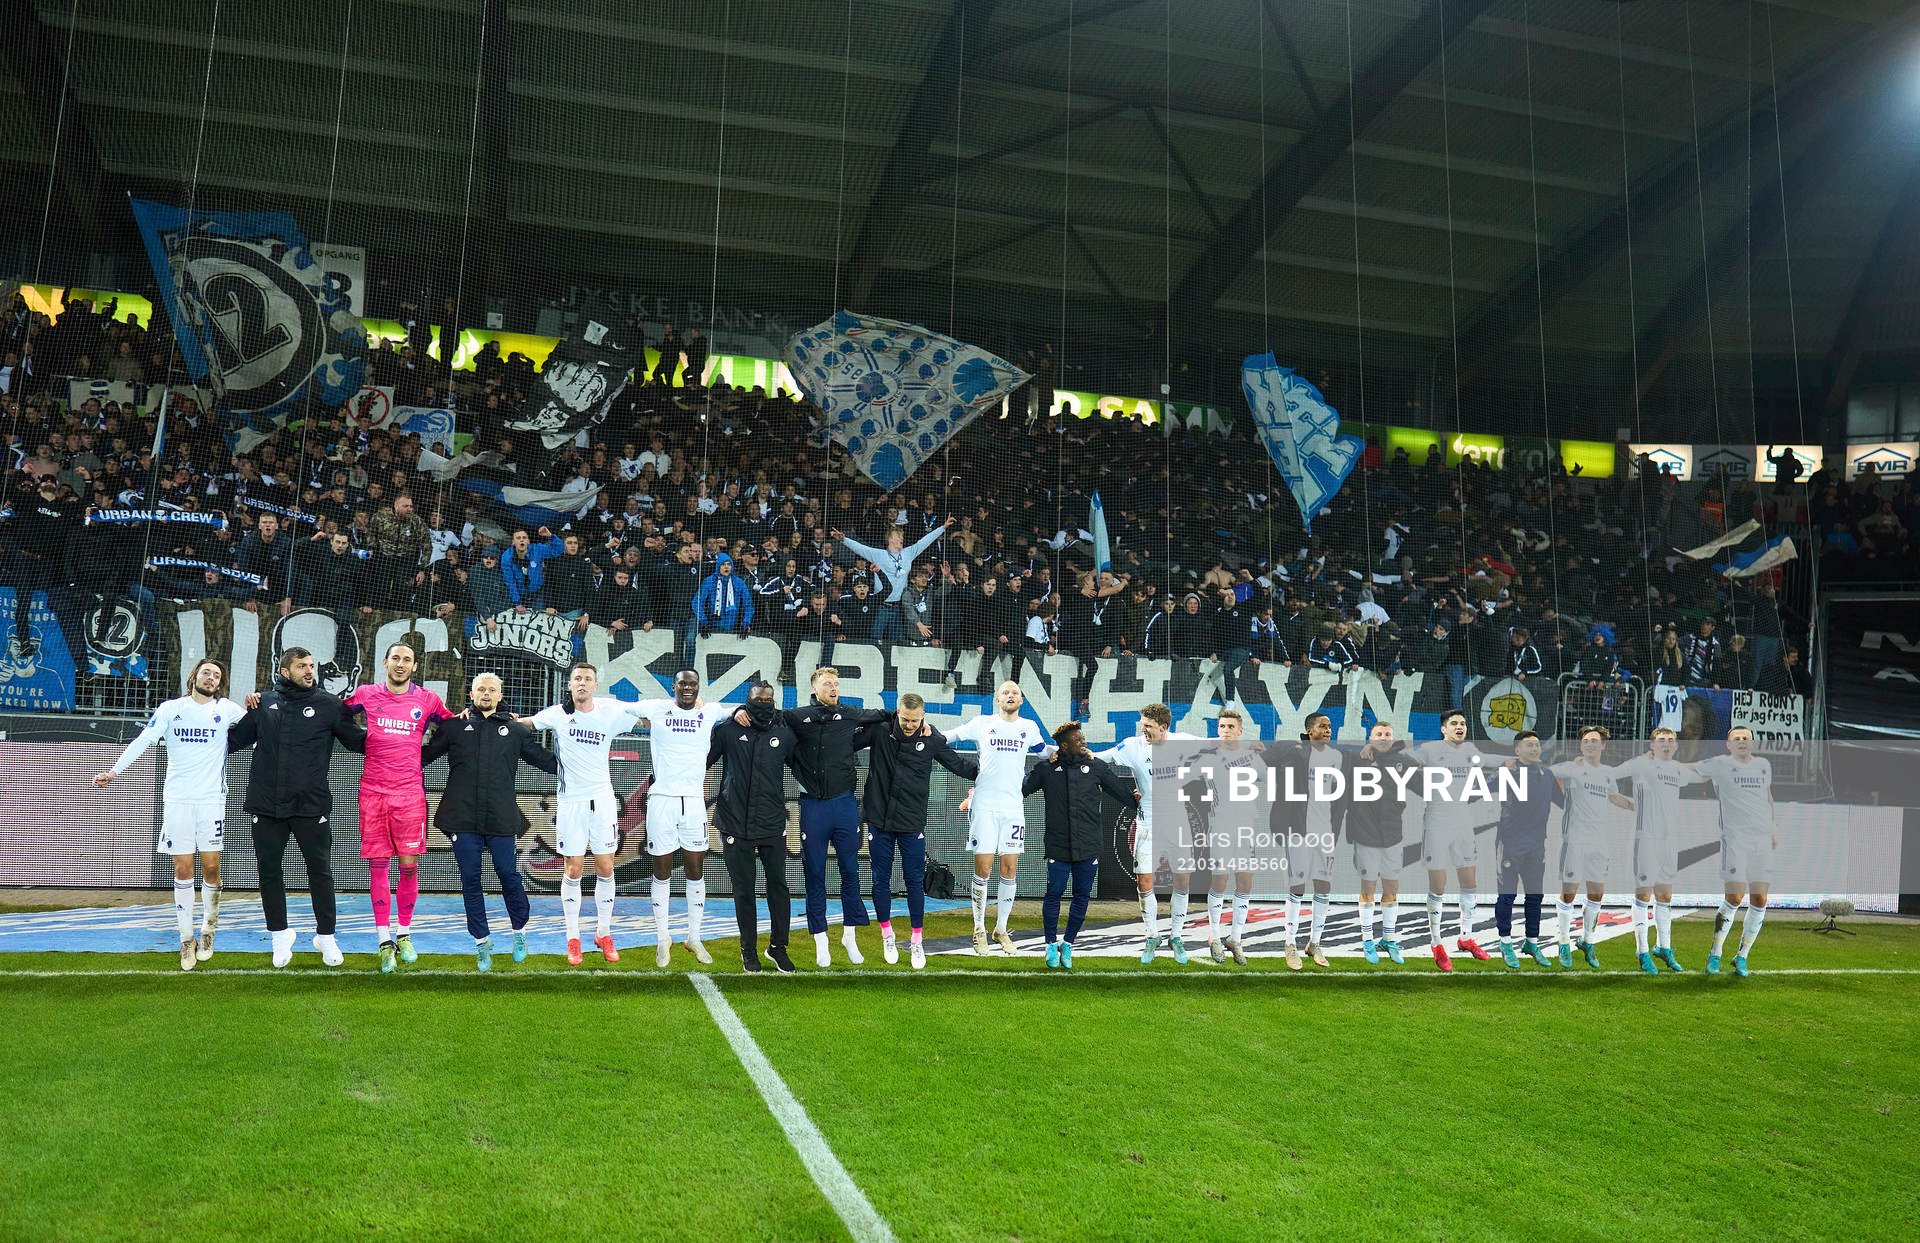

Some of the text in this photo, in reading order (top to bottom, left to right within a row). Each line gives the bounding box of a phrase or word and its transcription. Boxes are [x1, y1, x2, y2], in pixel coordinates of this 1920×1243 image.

[315, 249, 361, 261] OPGANG
[99, 509, 214, 524] URBAN CREW
[153, 556, 261, 584] URBAN BOYS
[0, 685, 44, 697] YOU'RE
[583, 623, 1424, 745] KØBENHAVN
[33, 699, 62, 709] NOW
[1666, 695, 1678, 712] 19
[1734, 691, 1753, 706] HEJ
[1733, 706, 1799, 726] får jag fråga
[377, 718, 418, 731] UNIBET
[666, 719, 702, 728] UNIBET
[174, 728, 217, 738] UNIBET
[569, 728, 606, 742] UNIBET
[990, 738, 1024, 748] UNIBET
[215, 820, 225, 837] 3
